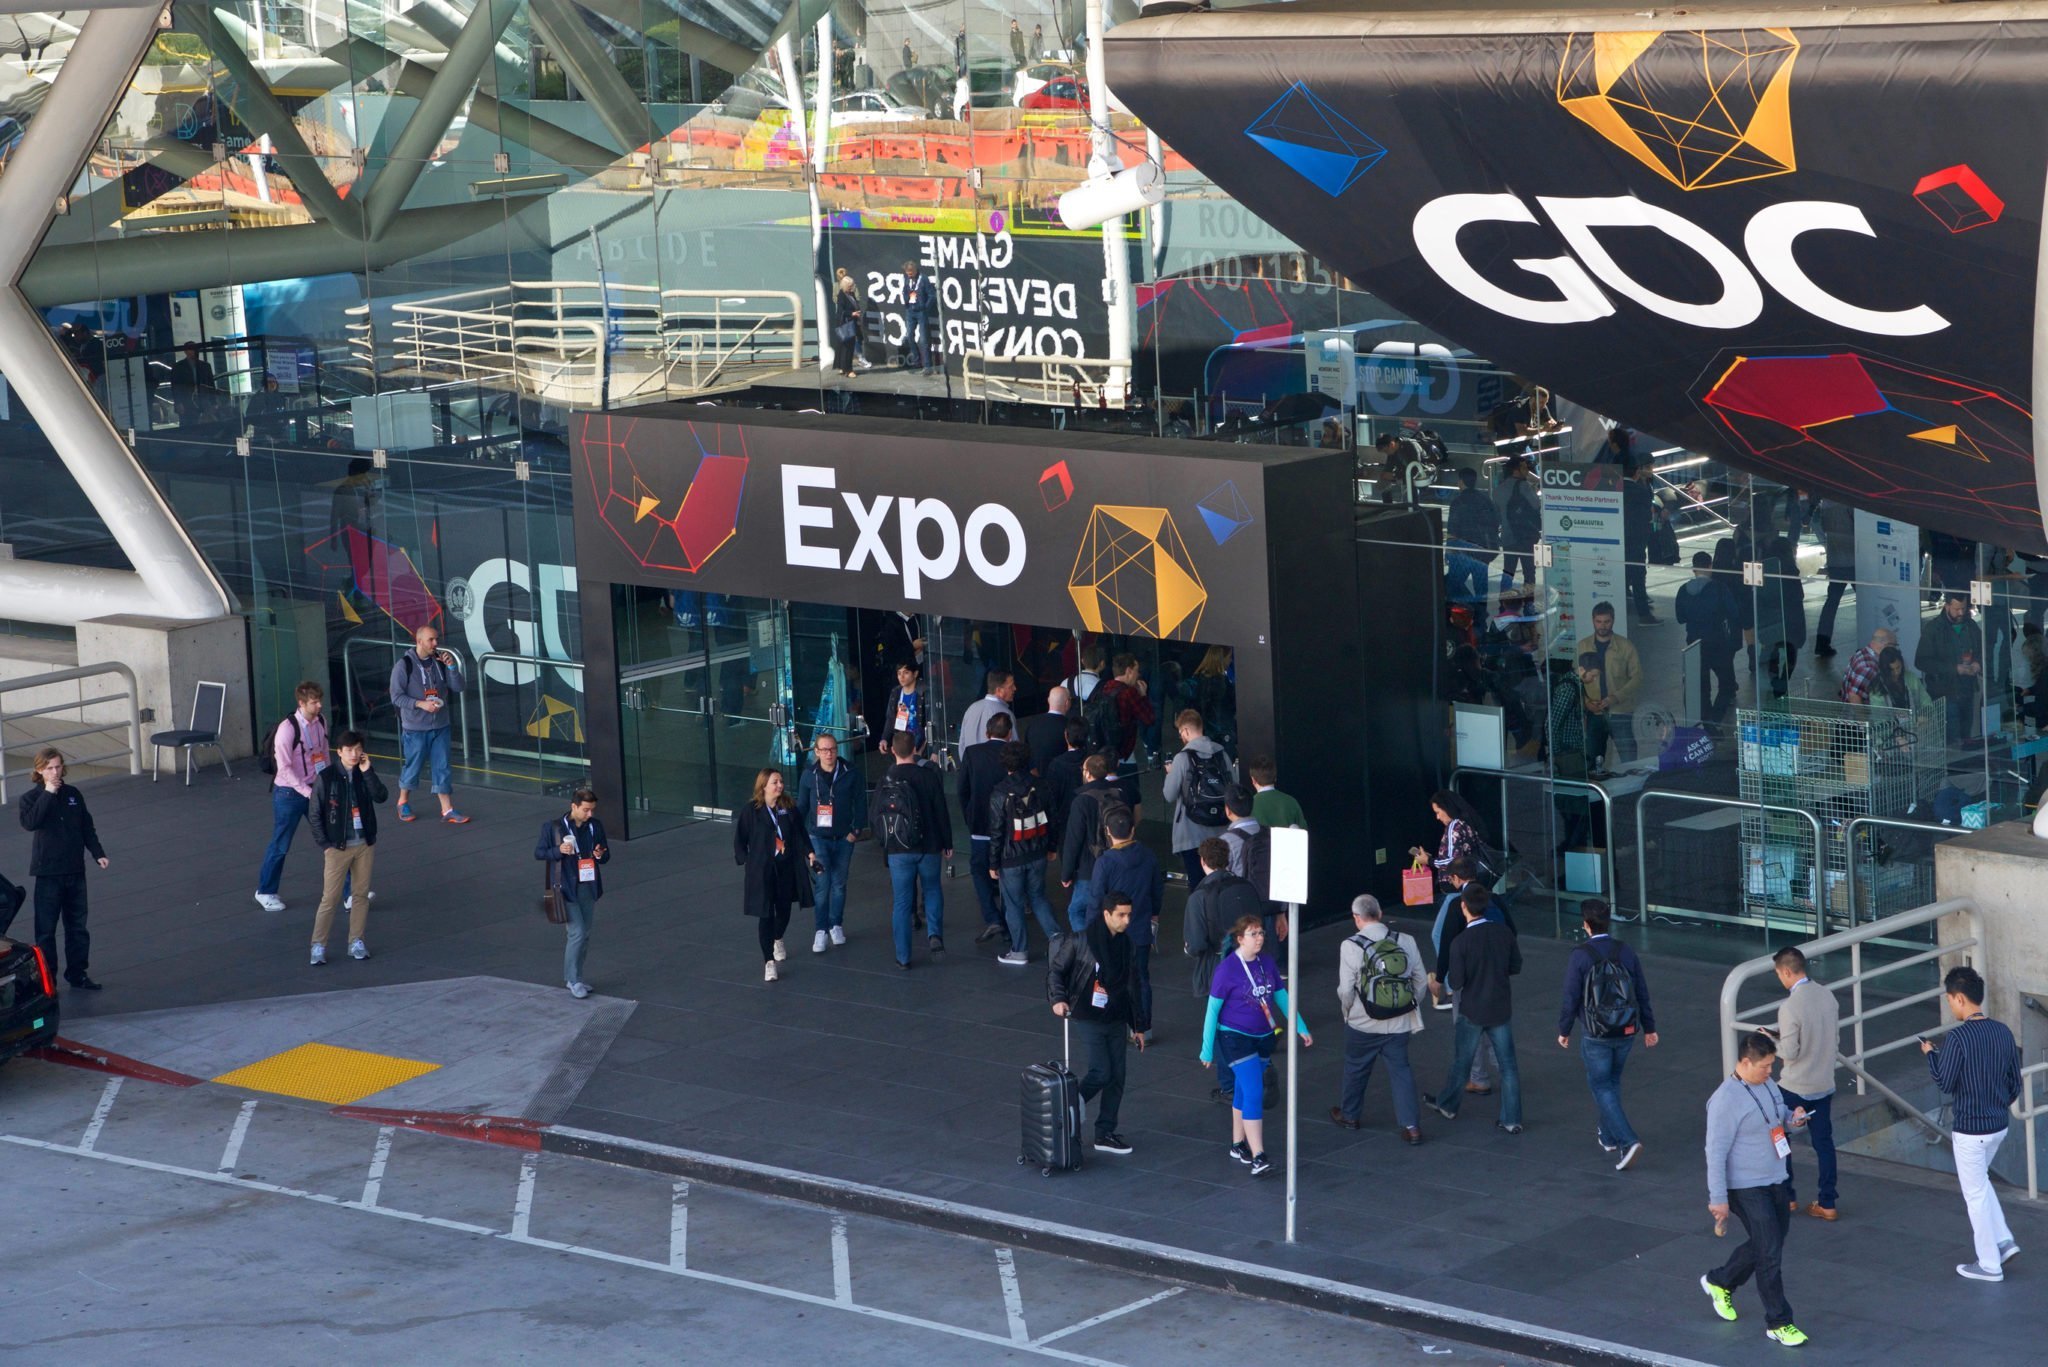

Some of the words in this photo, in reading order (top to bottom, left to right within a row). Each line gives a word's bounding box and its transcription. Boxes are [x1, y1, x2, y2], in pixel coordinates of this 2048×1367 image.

[1412, 192, 1951, 336] GDC
[105, 336, 125, 349] GDC
[1543, 468, 1582, 487] GDC
[1594, 496, 1619, 504] Partners
[781, 464, 1027, 600] Expo
[1687, 741, 1701, 753] ASK
[1689, 748, 1705, 760] CAN
[1252, 985, 1272, 997] GDC
